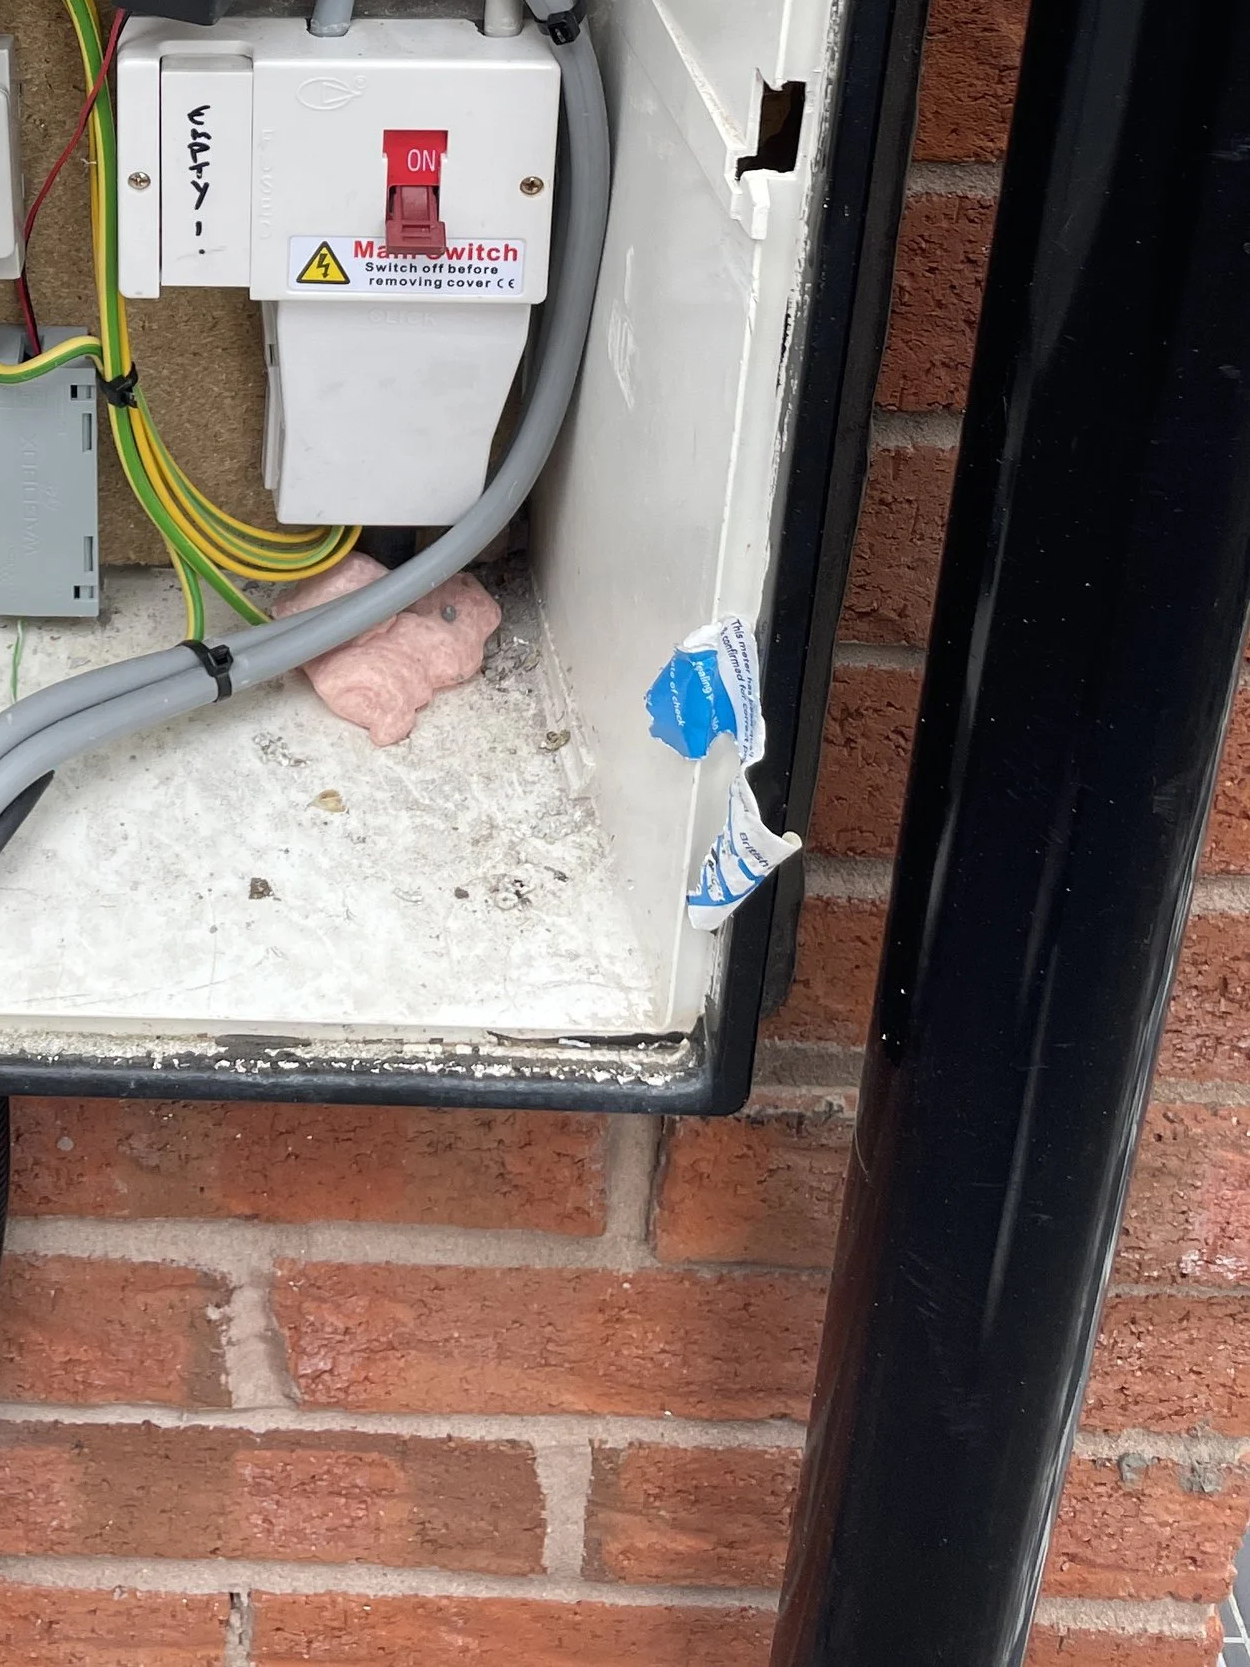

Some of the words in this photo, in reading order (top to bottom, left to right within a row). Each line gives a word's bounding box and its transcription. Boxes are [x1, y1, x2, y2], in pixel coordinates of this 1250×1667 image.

[407, 148, 436, 172] ON
[353, 240, 419, 260] Ma
[428, 241, 518, 262] witch
[365, 261, 418, 274] Switch
[422, 262, 444, 275] off
[447, 263, 499, 275] before
[368, 277, 443, 289] removing
[446, 279, 492, 289] cover
[721, 635, 745, 682] confirmed
[731, 618, 745, 640] This
[738, 641, 752, 675] meter
[739, 831, 770, 868] British
